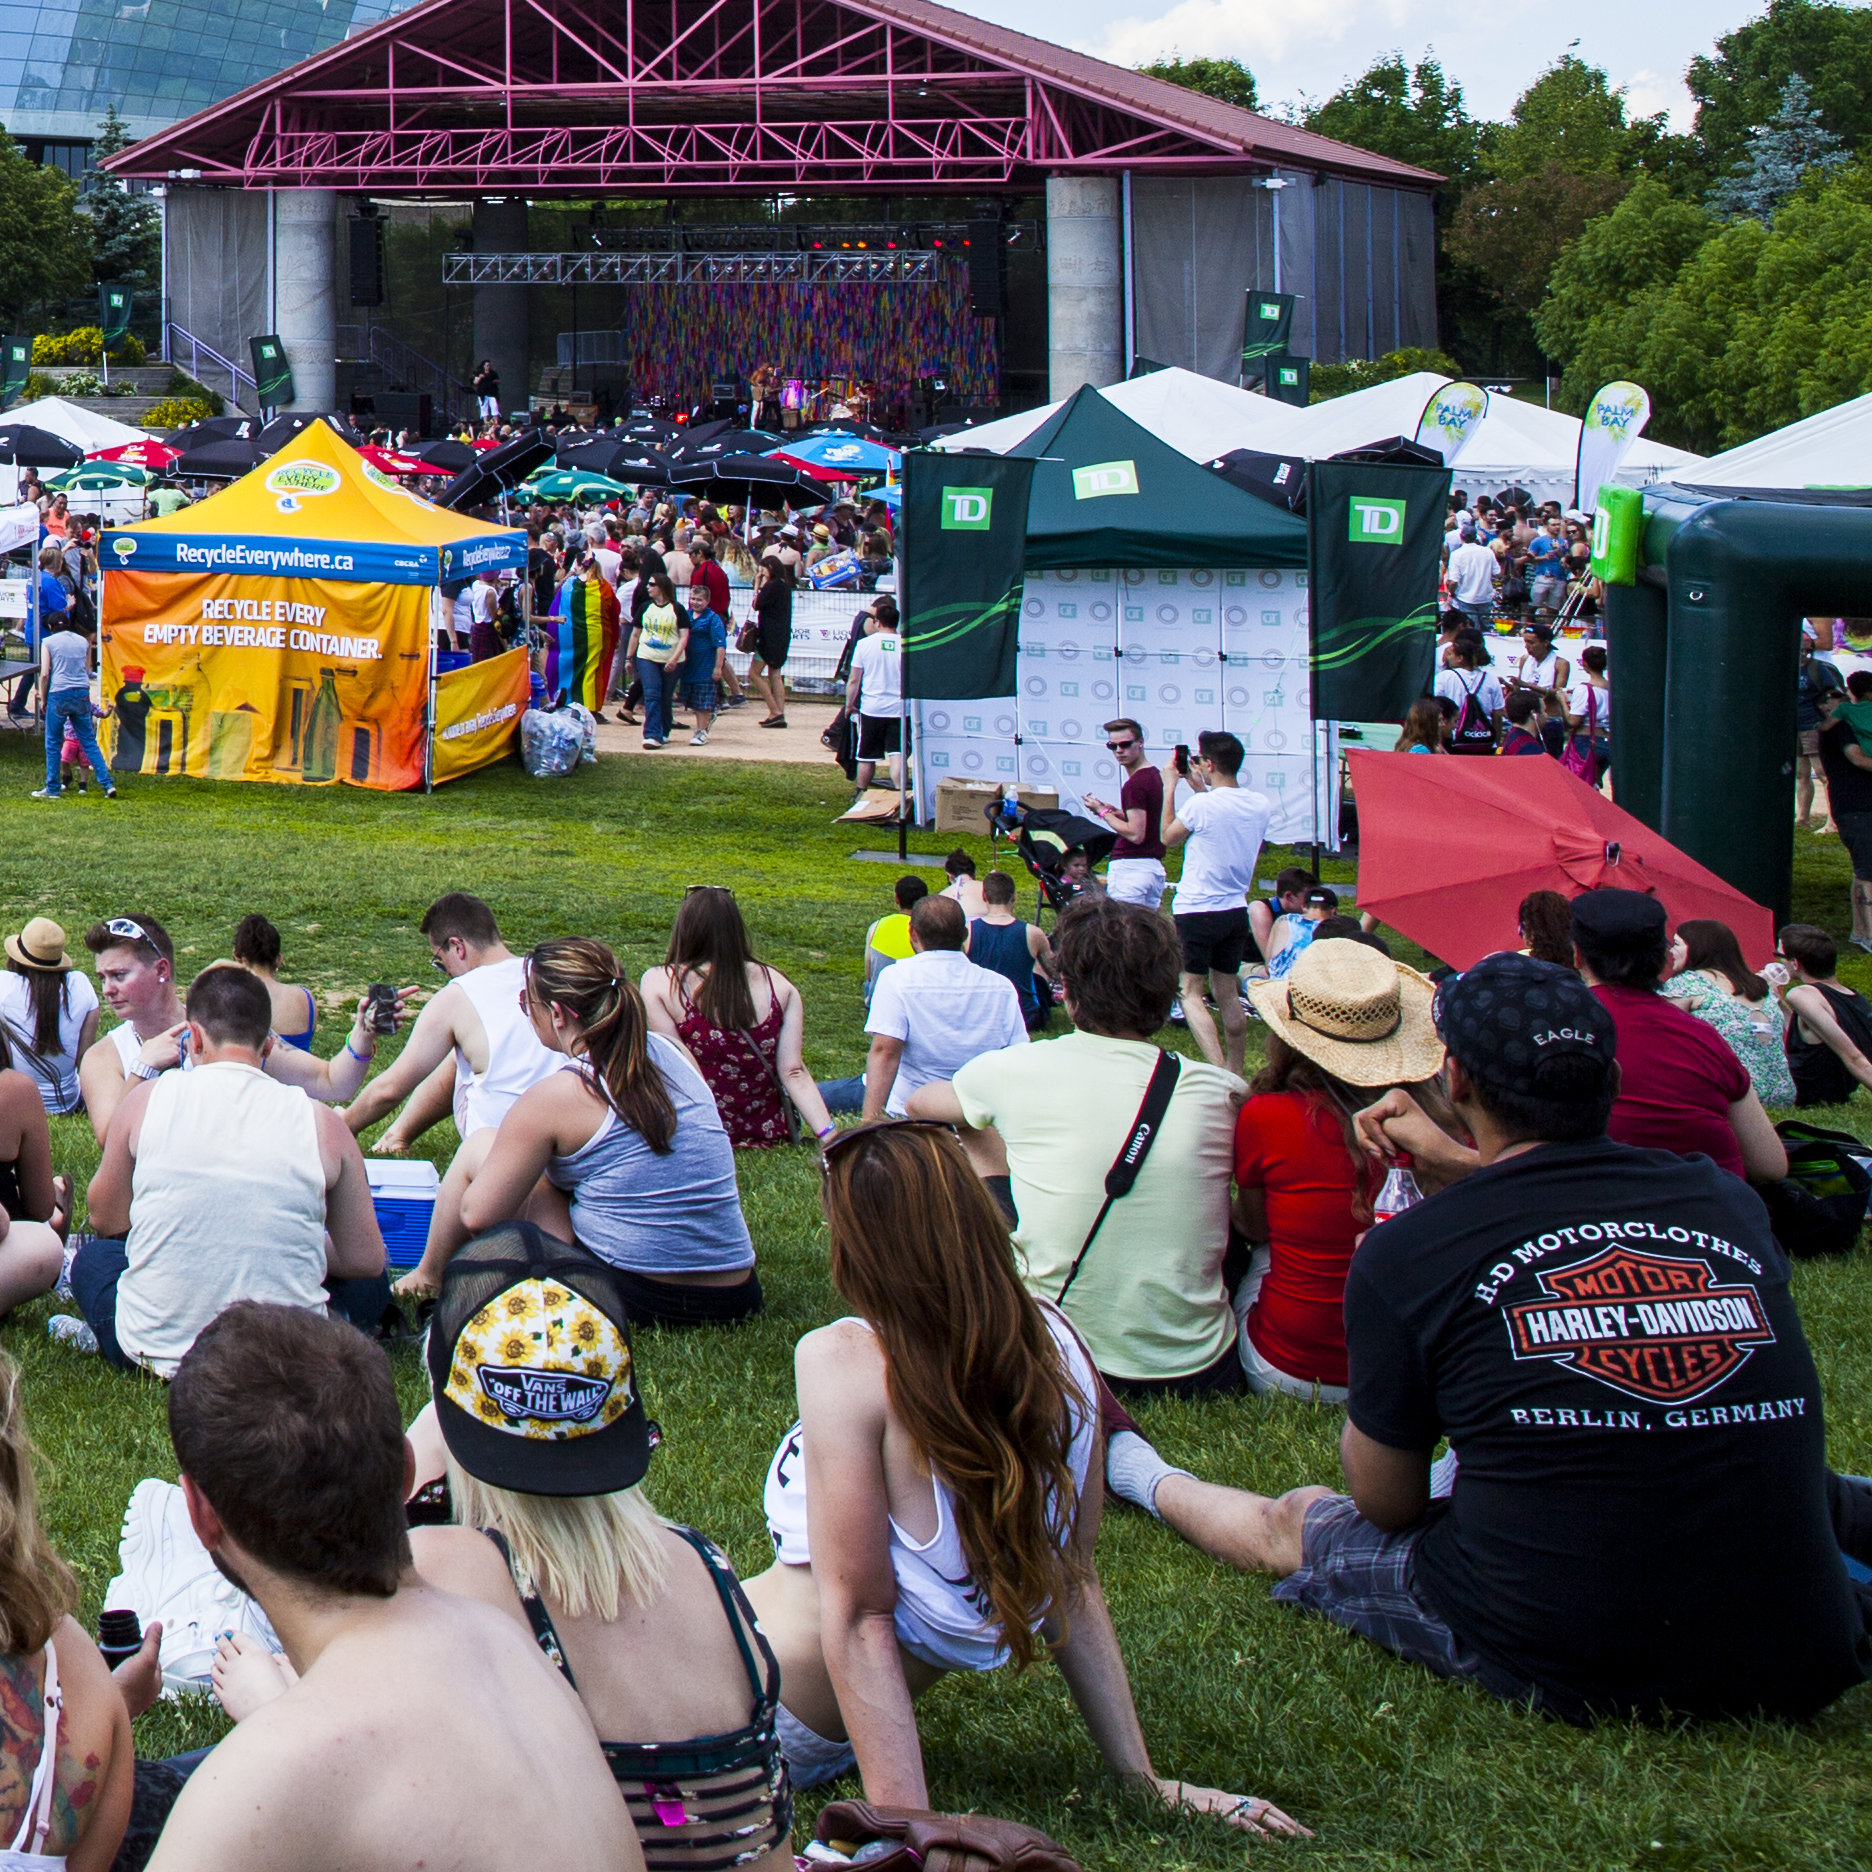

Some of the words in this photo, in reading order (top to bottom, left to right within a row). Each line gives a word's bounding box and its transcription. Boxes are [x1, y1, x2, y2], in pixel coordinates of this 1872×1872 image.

[1263, 306, 1279, 318] TD
[1282, 371, 1297, 383] TD
[1436, 403, 1472, 420] PALM
[1438, 414, 1467, 428] BAY
[1597, 403, 1633, 420] PALM
[1601, 413, 1629, 428] BAY
[284, 479, 329, 491] WHERE
[1079, 469, 1131, 491] TD
[948, 494, 987, 522] TD
[1355, 504, 1400, 535] TD
[176, 543, 354, 572] RecycleEverywhere.ca
[202, 599, 272, 622] RECYCLE
[274, 601, 326, 627] EVERY
[144, 624, 199, 645] EMPTY
[201, 625, 286, 649] BEVERAGE
[289, 630, 383, 660] CONTAINER.
[1533, 1027, 1595, 1047] EAGLE
[1124, 1122, 1150, 1165] Canon
[1474, 1262, 1515, 1305] H-D
[1512, 1222, 1762, 1276] MOTORCLOTHES
[1573, 1260, 1695, 1297] MOTOR
[1525, 1296, 1758, 1344] HARLEY-DAVIDSON
[1599, 1344, 1722, 1389] CYCLES
[525, 1390, 557, 1412] THE
[1511, 1409, 1651, 1430] BERLIN,
[1664, 1397, 1806, 1428] GERMANY
